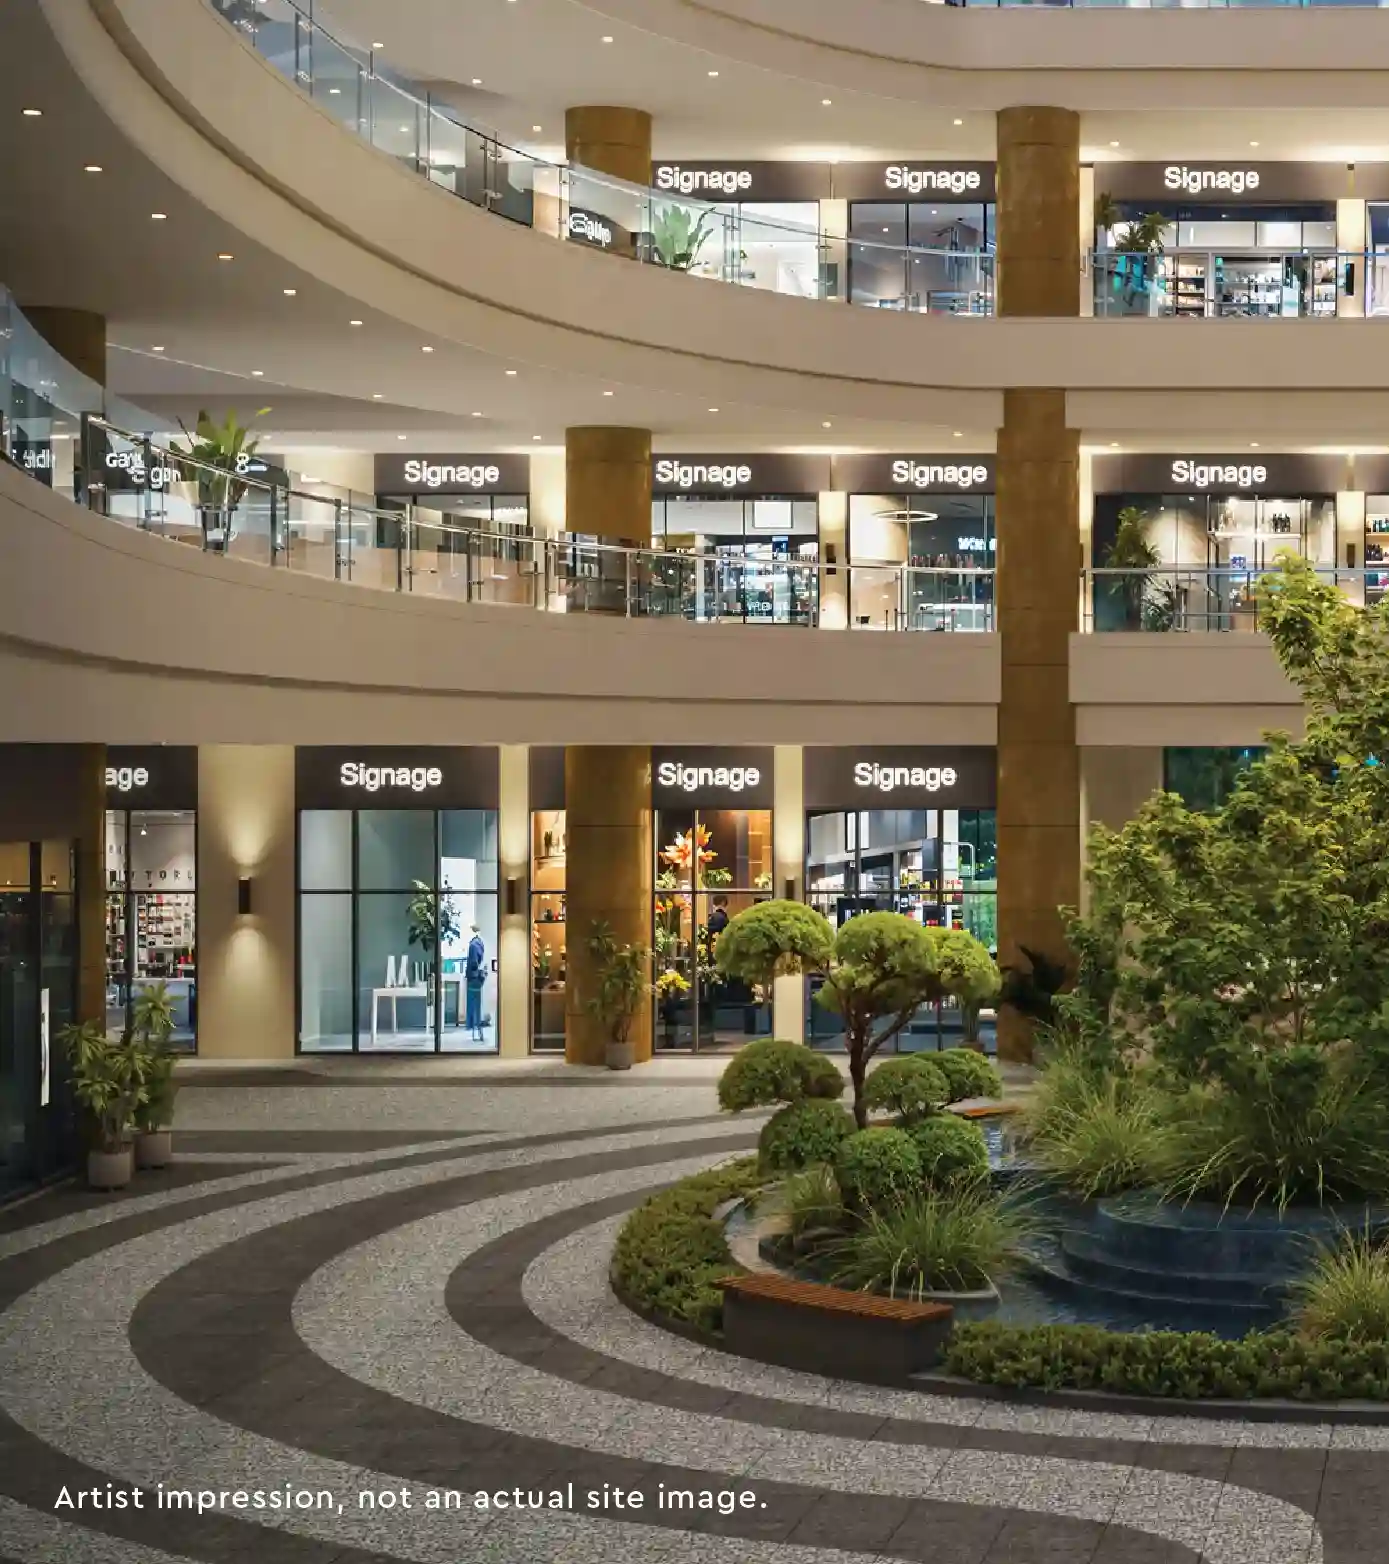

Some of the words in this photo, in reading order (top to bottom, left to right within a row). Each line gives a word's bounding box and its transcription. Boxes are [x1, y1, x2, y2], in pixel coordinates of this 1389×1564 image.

[656, 167, 752, 193] Signage
[885, 167, 980, 193] Signage
[1164, 167, 1260, 193] Signage
[404, 460, 500, 487] Signage
[656, 460, 751, 487] Signage
[893, 460, 987, 487] Signage
[1171, 460, 1267, 487] Signage
[340, 763, 443, 791] Signage
[658, 763, 760, 791] Signage
[855, 763, 957, 791] Signage
